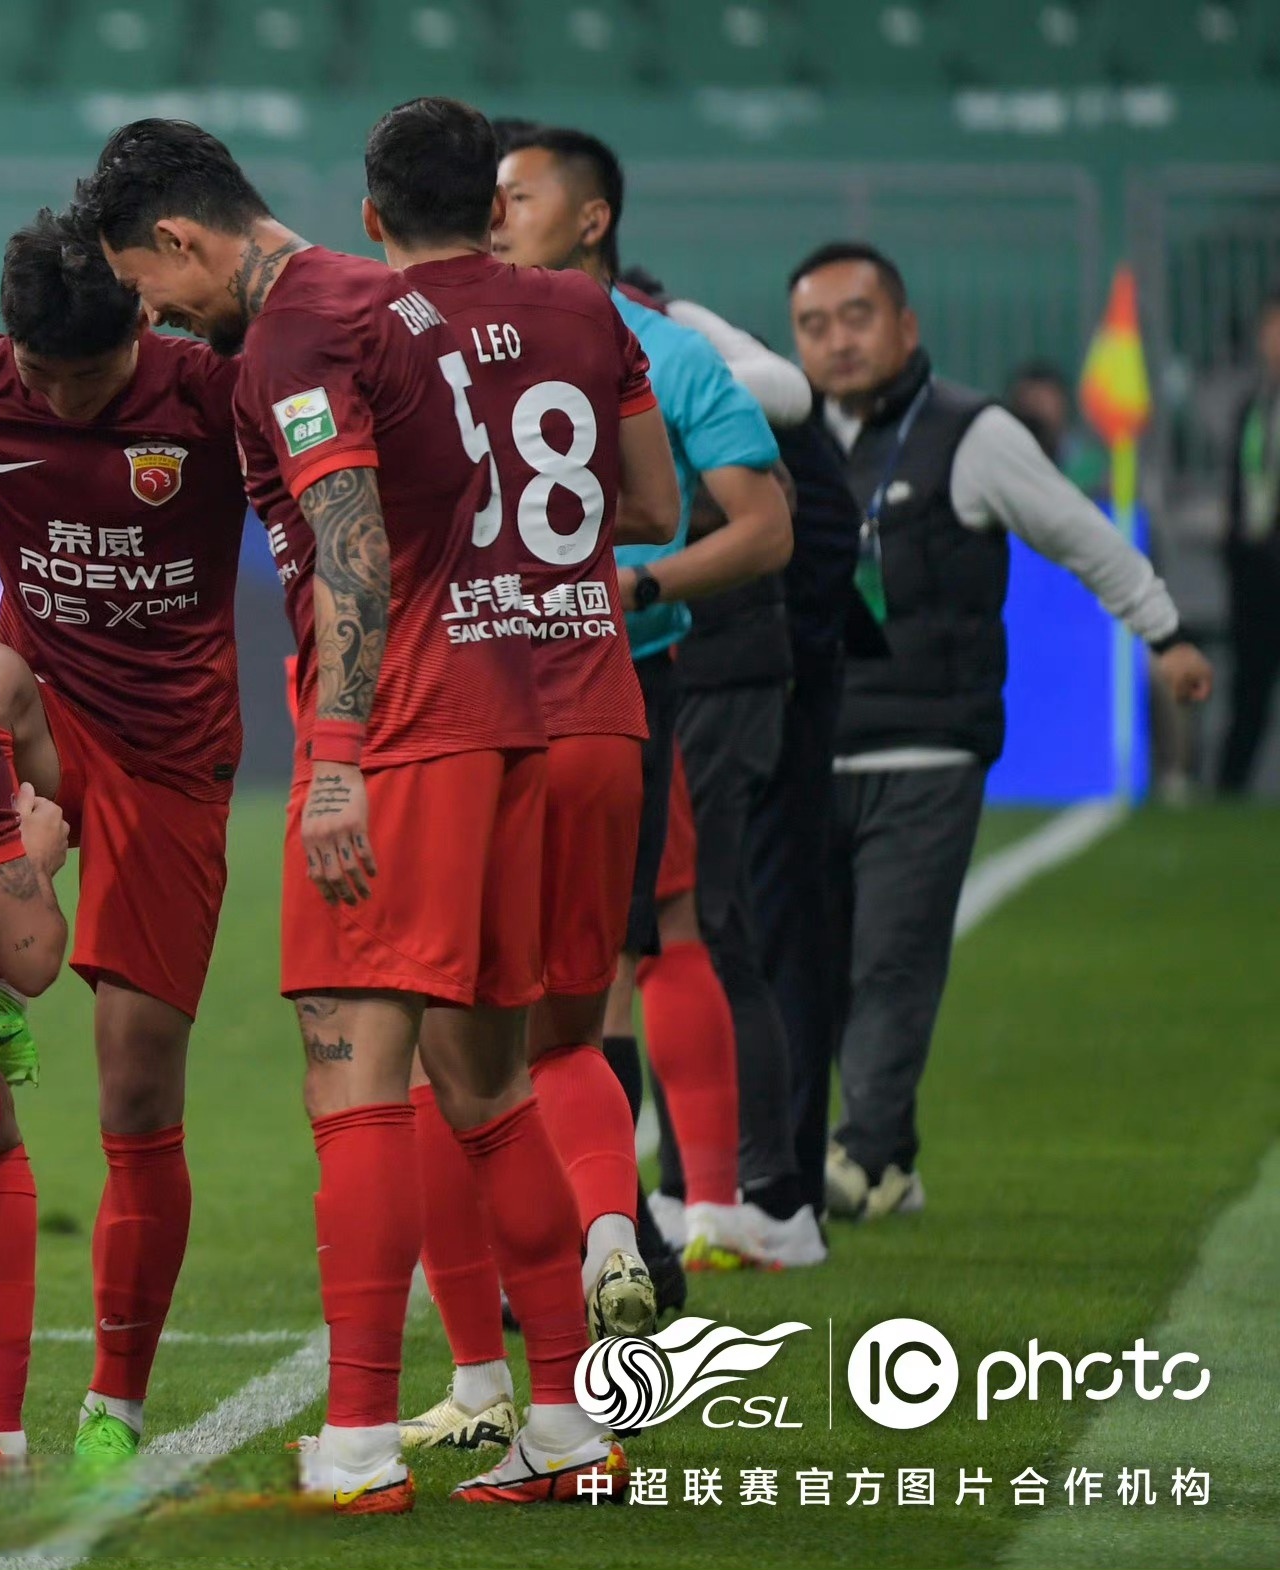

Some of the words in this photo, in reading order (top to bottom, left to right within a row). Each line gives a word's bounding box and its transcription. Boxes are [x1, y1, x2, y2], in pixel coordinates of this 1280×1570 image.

[472, 323, 521, 363] LEO
[512, 380, 605, 566] 8
[48, 519, 145, 557] 荣威
[20, 546, 195, 591] ROEWE
[447, 621, 493, 644] SAIC
